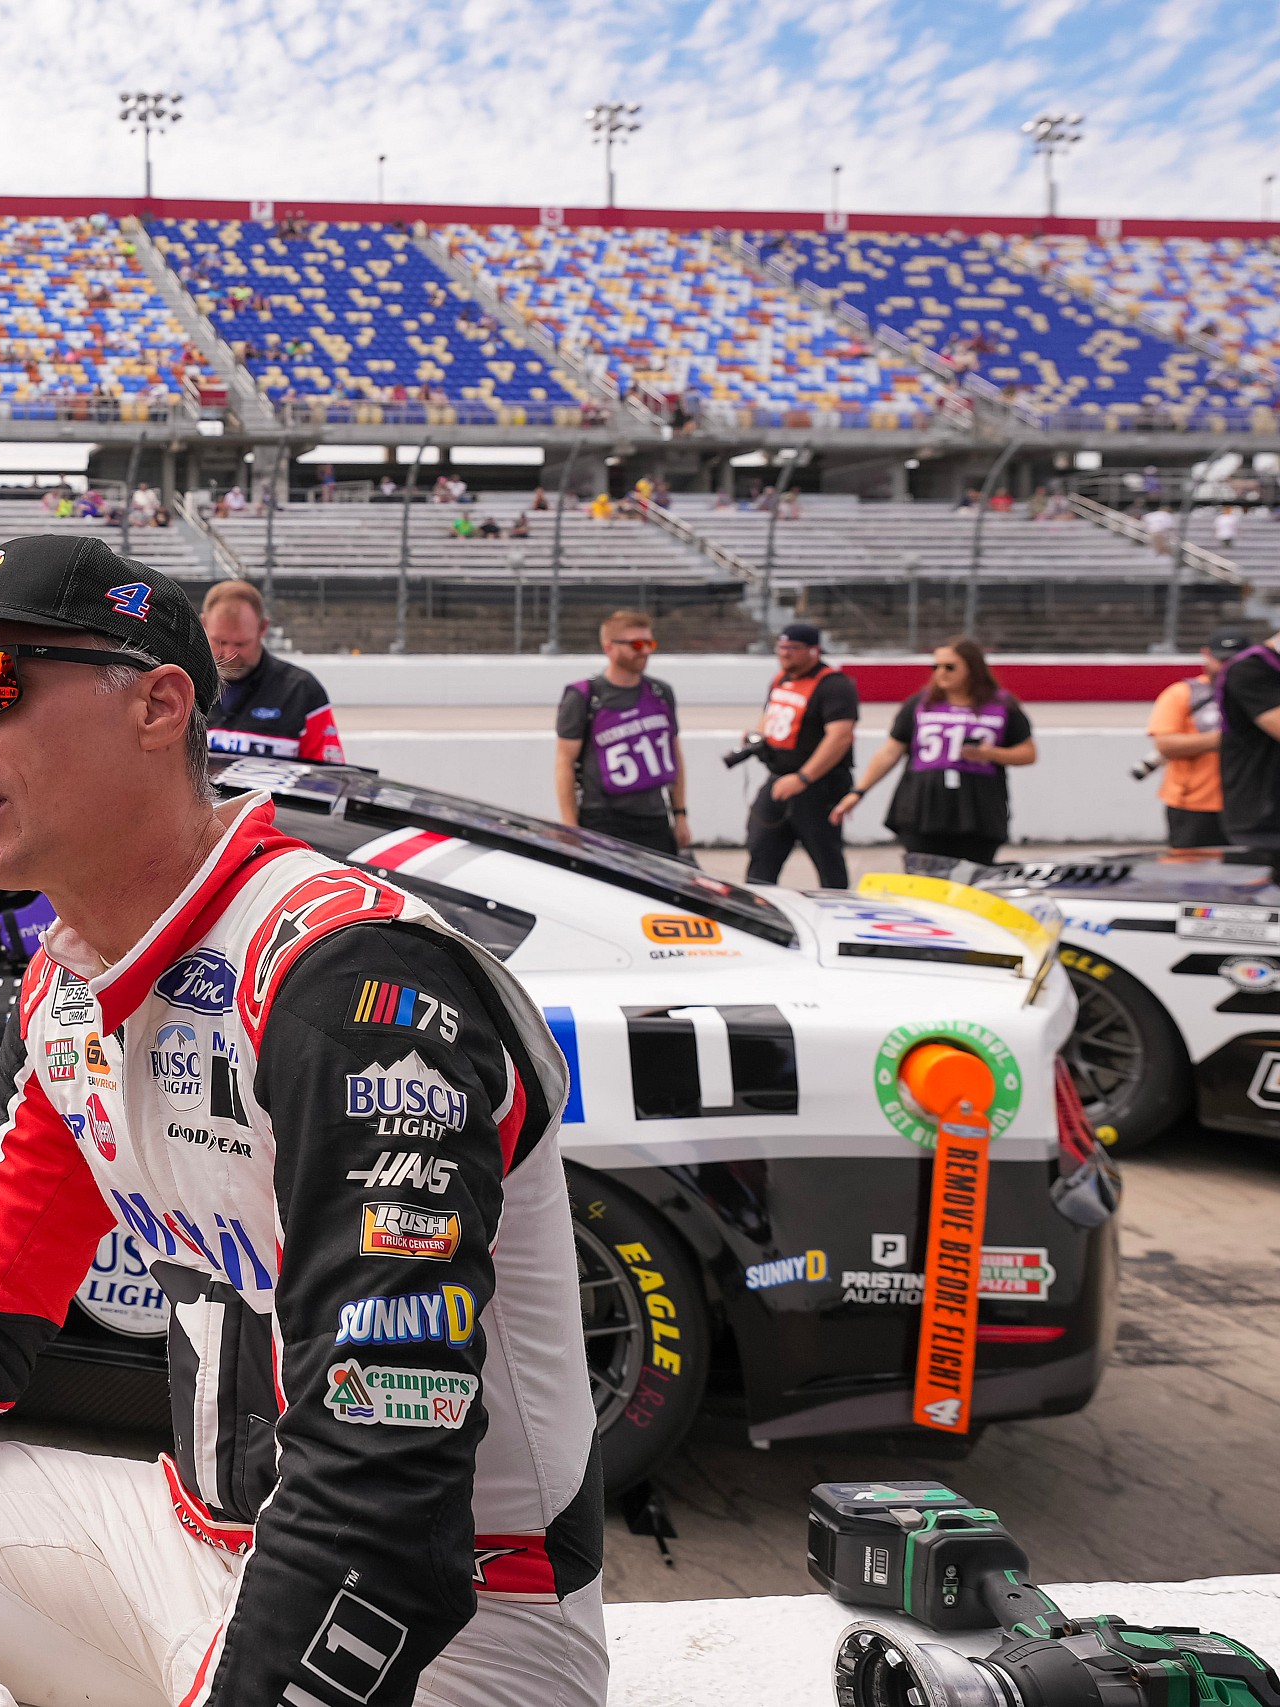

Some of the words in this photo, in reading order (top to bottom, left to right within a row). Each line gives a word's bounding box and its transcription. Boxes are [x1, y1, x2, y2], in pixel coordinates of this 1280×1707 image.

[105, 582, 154, 622] 4
[605, 731, 675, 787] 511
[652, 919, 714, 938] GW
[1058, 949, 1114, 981] GLE
[417, 992, 459, 1043] 75
[346, 1074, 468, 1133] BUSCH
[376, 1117, 447, 1142] LIGHT
[346, 1152, 459, 1194] HAAS
[940, 1147, 979, 1233] REMOVE
[380, 1234, 408, 1248] TRUCK
[408, 1238, 445, 1251] CENTERS
[745, 1249, 828, 1290] SUNNYD
[841, 1270, 925, 1289] PRISTIN
[934, 1239, 971, 1318] BEFORE
[87, 1280, 165, 1309] LIGH
[335, 1284, 475, 1345] SUNNYD
[615, 1242, 682, 1376] EAGLE
[841, 1288, 925, 1305] AUCTIO
[928, 1321, 966, 1395] FLIGHT
[366, 1371, 471, 1398] campers
[384, 1395, 430, 1421] inn
[433, 1397, 466, 1423] RV
[923, 1397, 963, 1427] 4
[325, 1622, 388, 1671] 1
